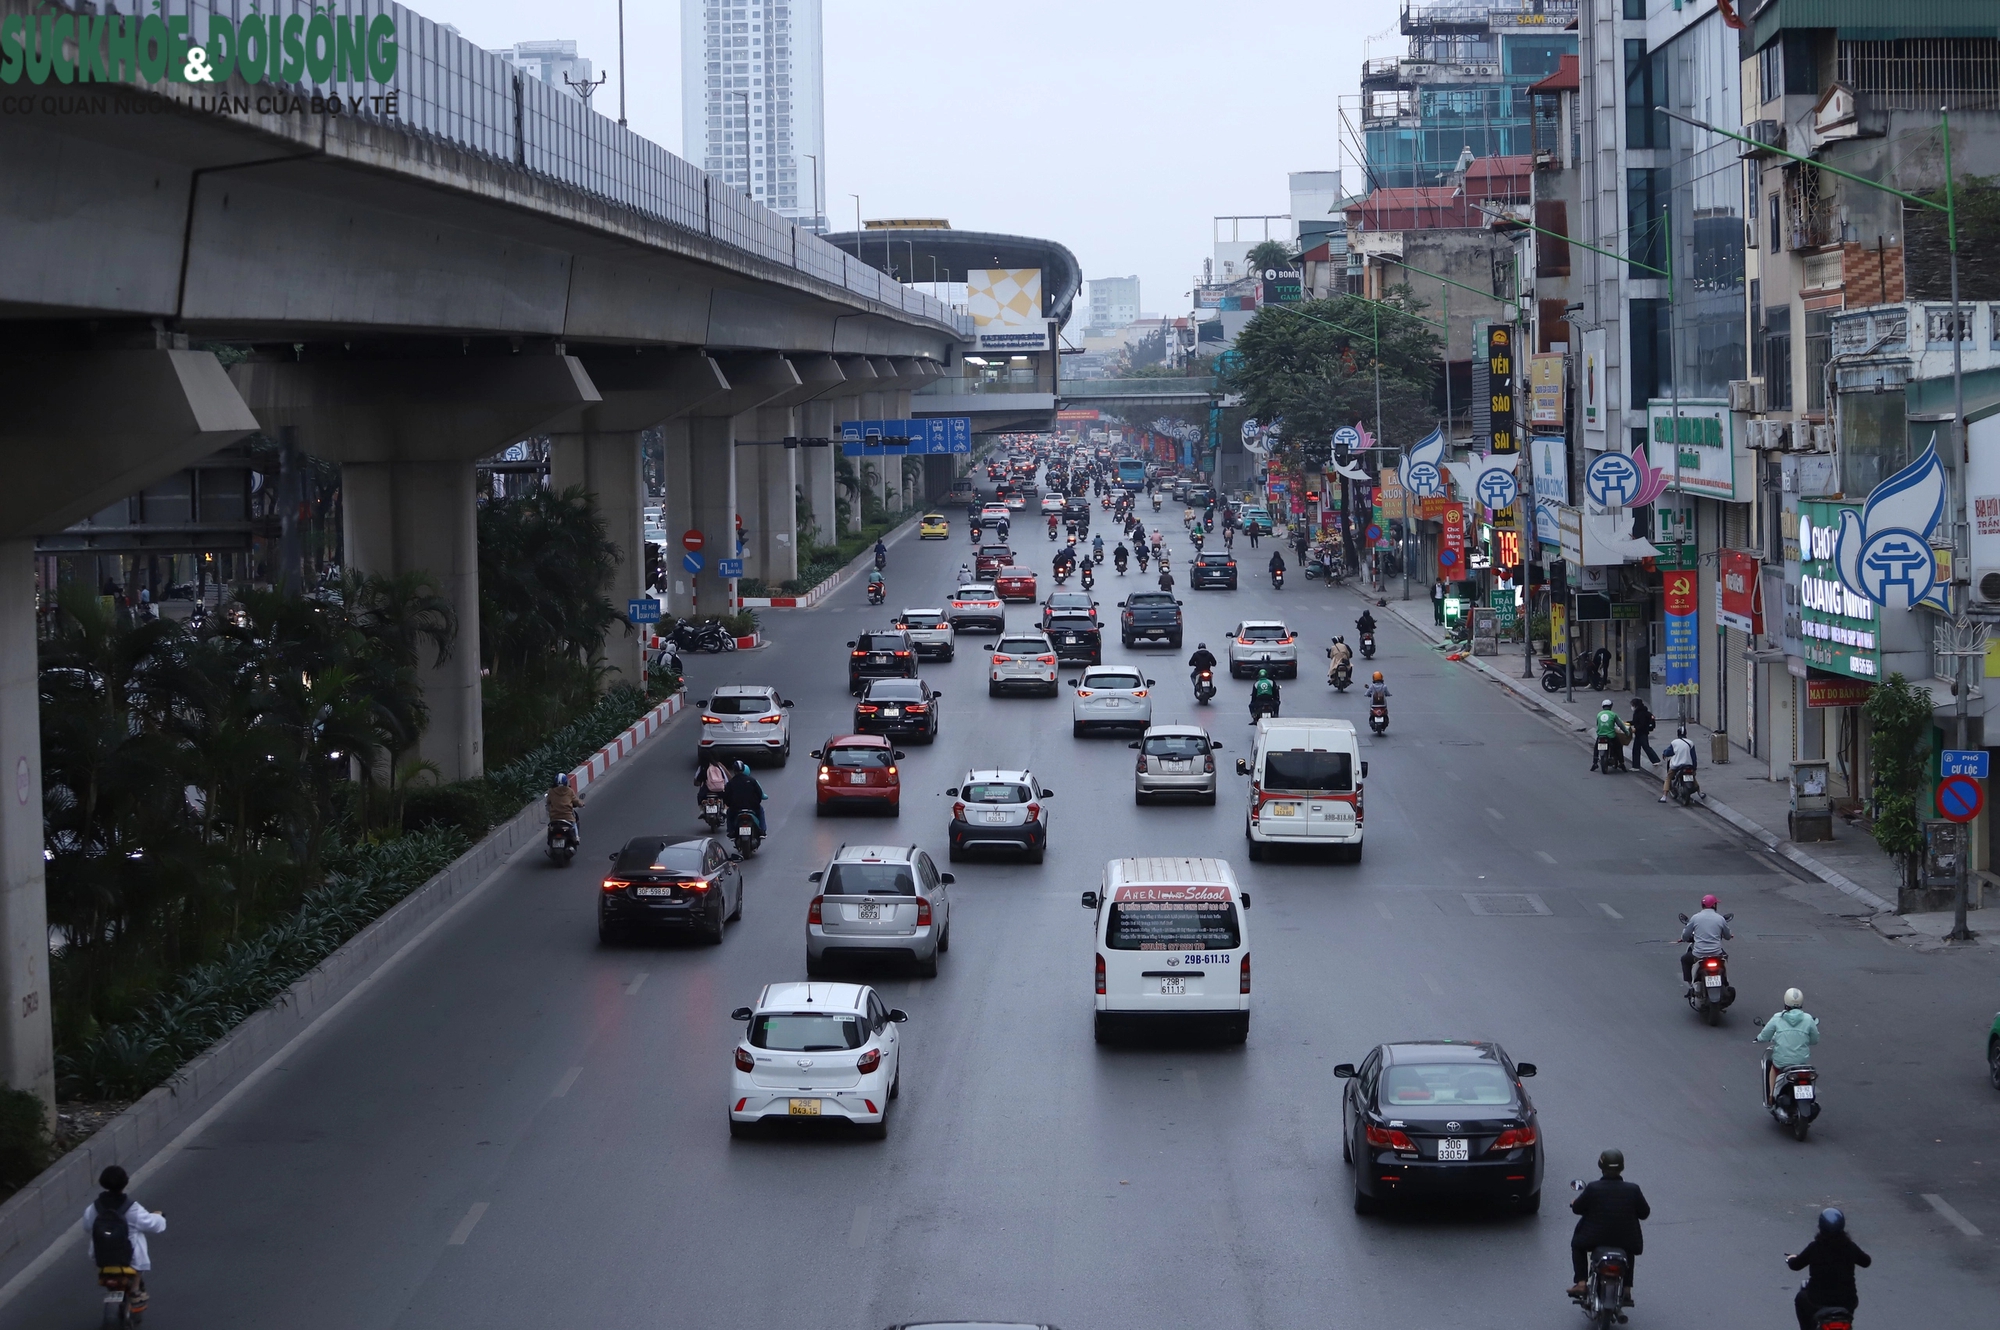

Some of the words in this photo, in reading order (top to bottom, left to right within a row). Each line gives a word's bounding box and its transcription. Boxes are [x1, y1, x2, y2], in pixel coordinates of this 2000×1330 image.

[1516, 14, 1545, 25] SAM
[1279, 270, 1300, 278] BOMB
[1491, 353, 1509, 374] YẾN
[1492, 393, 1510, 412] SÀO
[1494, 430, 1509, 449] SÀI
[1801, 565, 1842, 615] QUẢNG
[1494, 596, 1513, 605] TRÁI
[1843, 586, 1872, 620] NINH
[1495, 604, 1513, 613] CÂY
[1810, 688, 1826, 700] MAY
[1827, 688, 1837, 699] ĐO
[1964, 763, 1978, 776] LỘC
[1184, 886, 1225, 900] School
[1184, 954, 1230, 964] 29B-611.13
[798, 1099, 812, 1107] 29E
[792, 1107, 818, 1115] 043.15
[1445, 1140, 1461, 1149] 30G
[1439, 1150, 1467, 1159] 330.57
